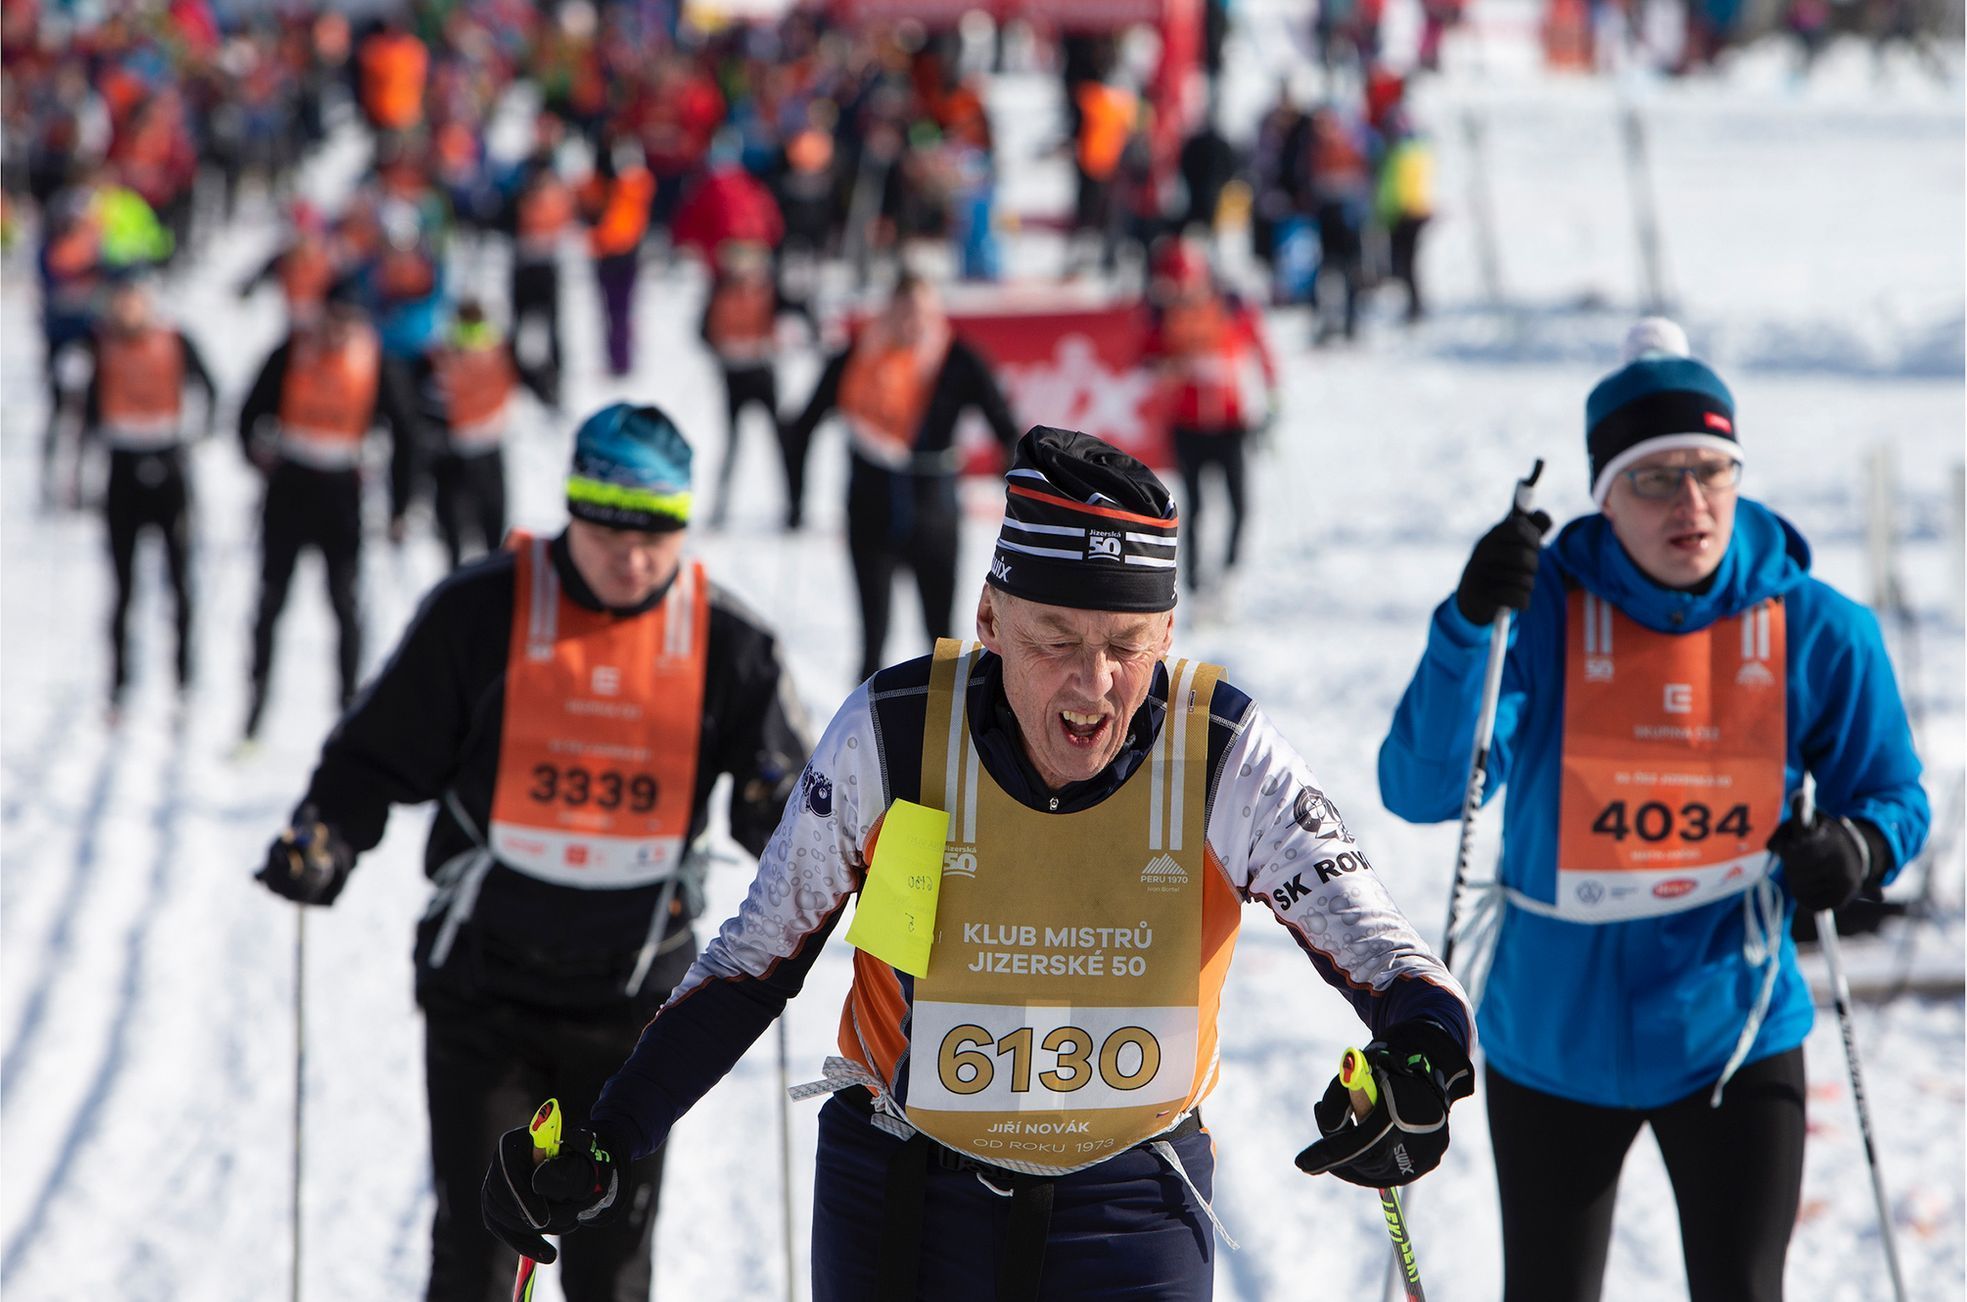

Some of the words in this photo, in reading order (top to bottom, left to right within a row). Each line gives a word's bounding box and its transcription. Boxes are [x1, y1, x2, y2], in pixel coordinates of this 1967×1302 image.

[1089, 529, 1121, 538] Jizerská
[1088, 536, 1121, 556] 50
[529, 762, 660, 815] 3339
[1592, 799, 1752, 842] 4034
[943, 852, 977, 872] 50
[1140, 875, 1166, 883] PERU
[1168, 876, 1189, 884] 1970
[1273, 872, 1312, 911] SK
[963, 923, 1037, 947] KLUB
[1044, 920, 1152, 949] MISTRŮ
[968, 950, 1104, 976] JIZERSKÉ
[1111, 956, 1147, 977] 50
[937, 1024, 1161, 1095] 6130
[987, 1121, 1023, 1134] JIŘÍ
[1025, 1120, 1090, 1135] NOVÁK
[973, 1138, 1003, 1149] OD
[1009, 1141, 1066, 1153] ROKU
[1075, 1138, 1115, 1153] 1973
